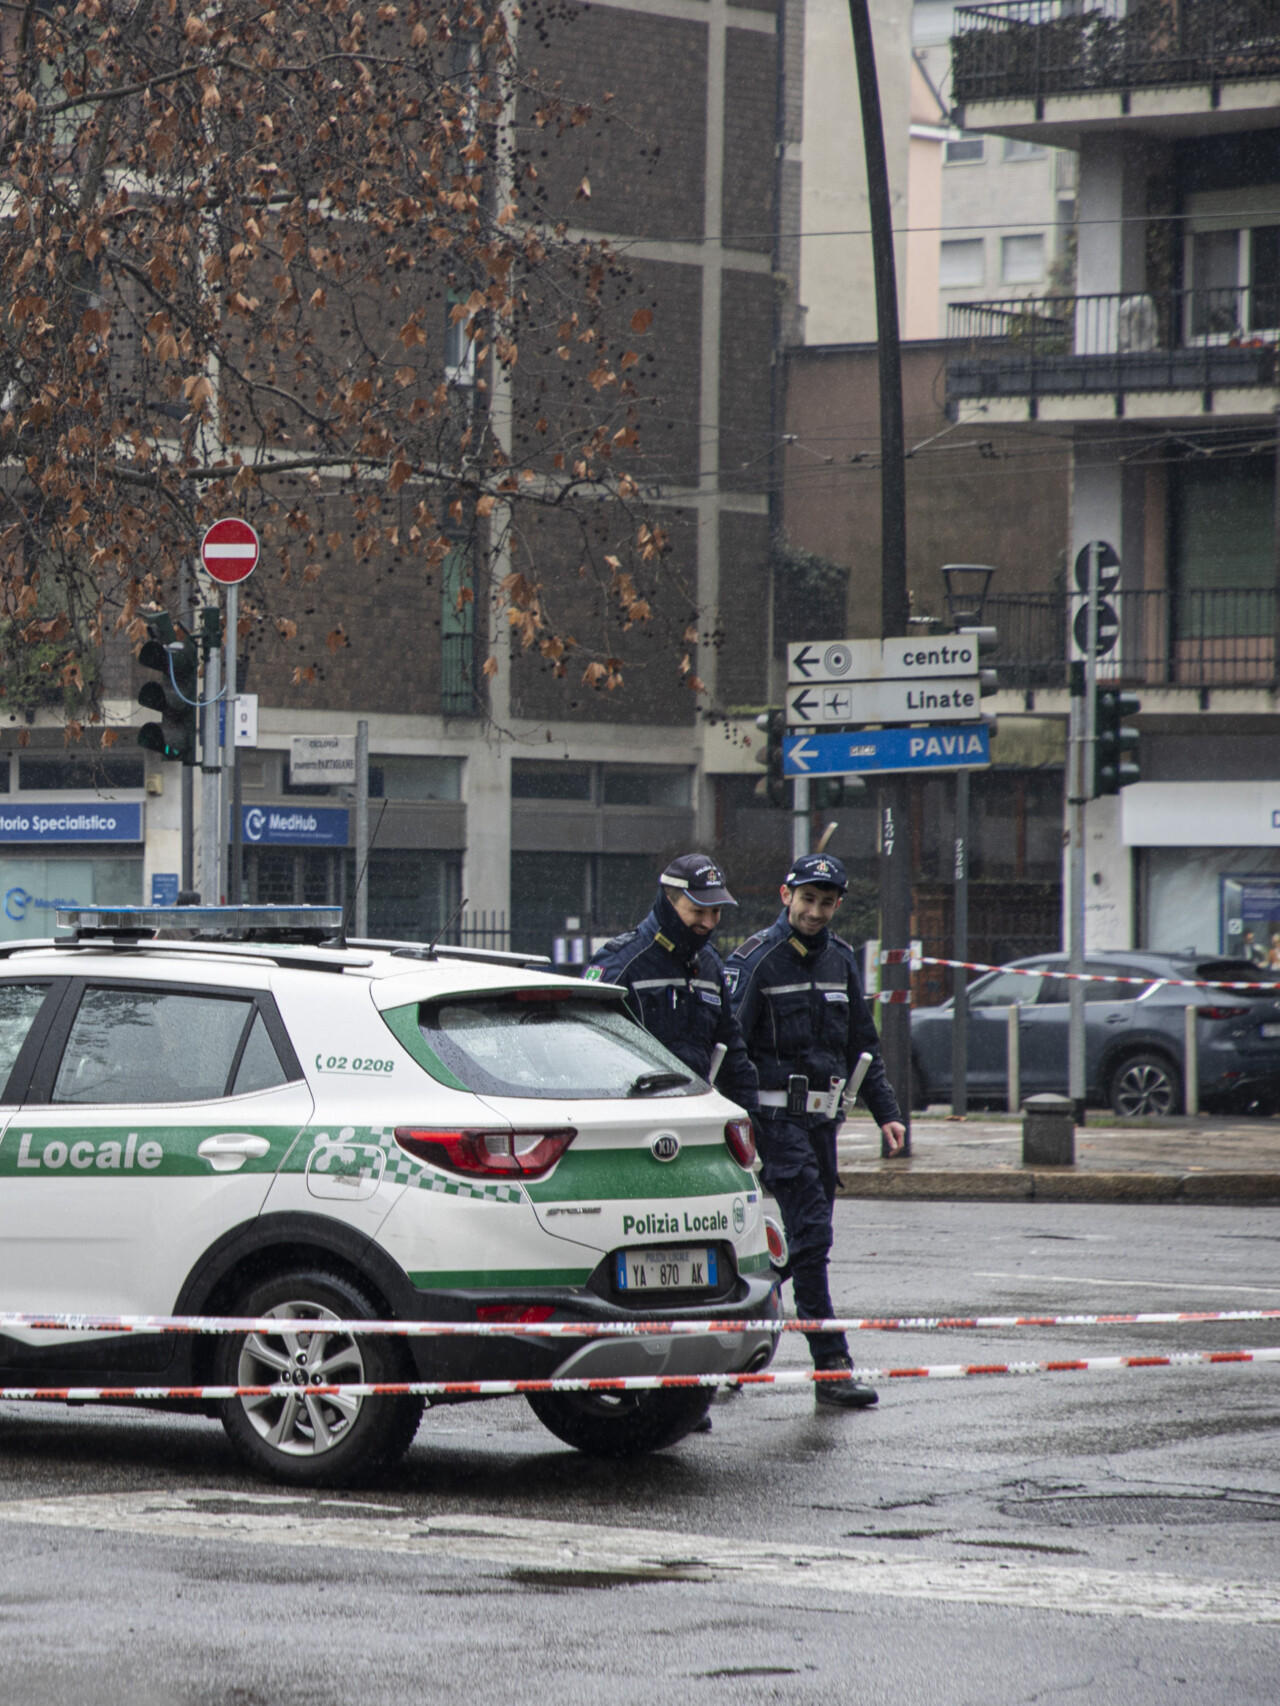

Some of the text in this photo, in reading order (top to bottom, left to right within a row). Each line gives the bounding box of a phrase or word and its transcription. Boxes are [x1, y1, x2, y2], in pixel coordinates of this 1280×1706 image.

[903, 646, 972, 666] centro
[907, 690, 974, 709] Linate
[910, 734, 983, 757] PAVIA
[32, 816, 116, 833] Specialistico
[269, 813, 317, 831] MedHub
[326, 1056, 394, 1072] 02 0208
[17, 1133, 163, 1169] Locale
[658, 1140, 676, 1154] KIA
[623, 1210, 728, 1235] Polizia Locale
[633, 1265, 646, 1286] YA
[660, 1264, 679, 1285] 870
[691, 1263, 703, 1284] AK
